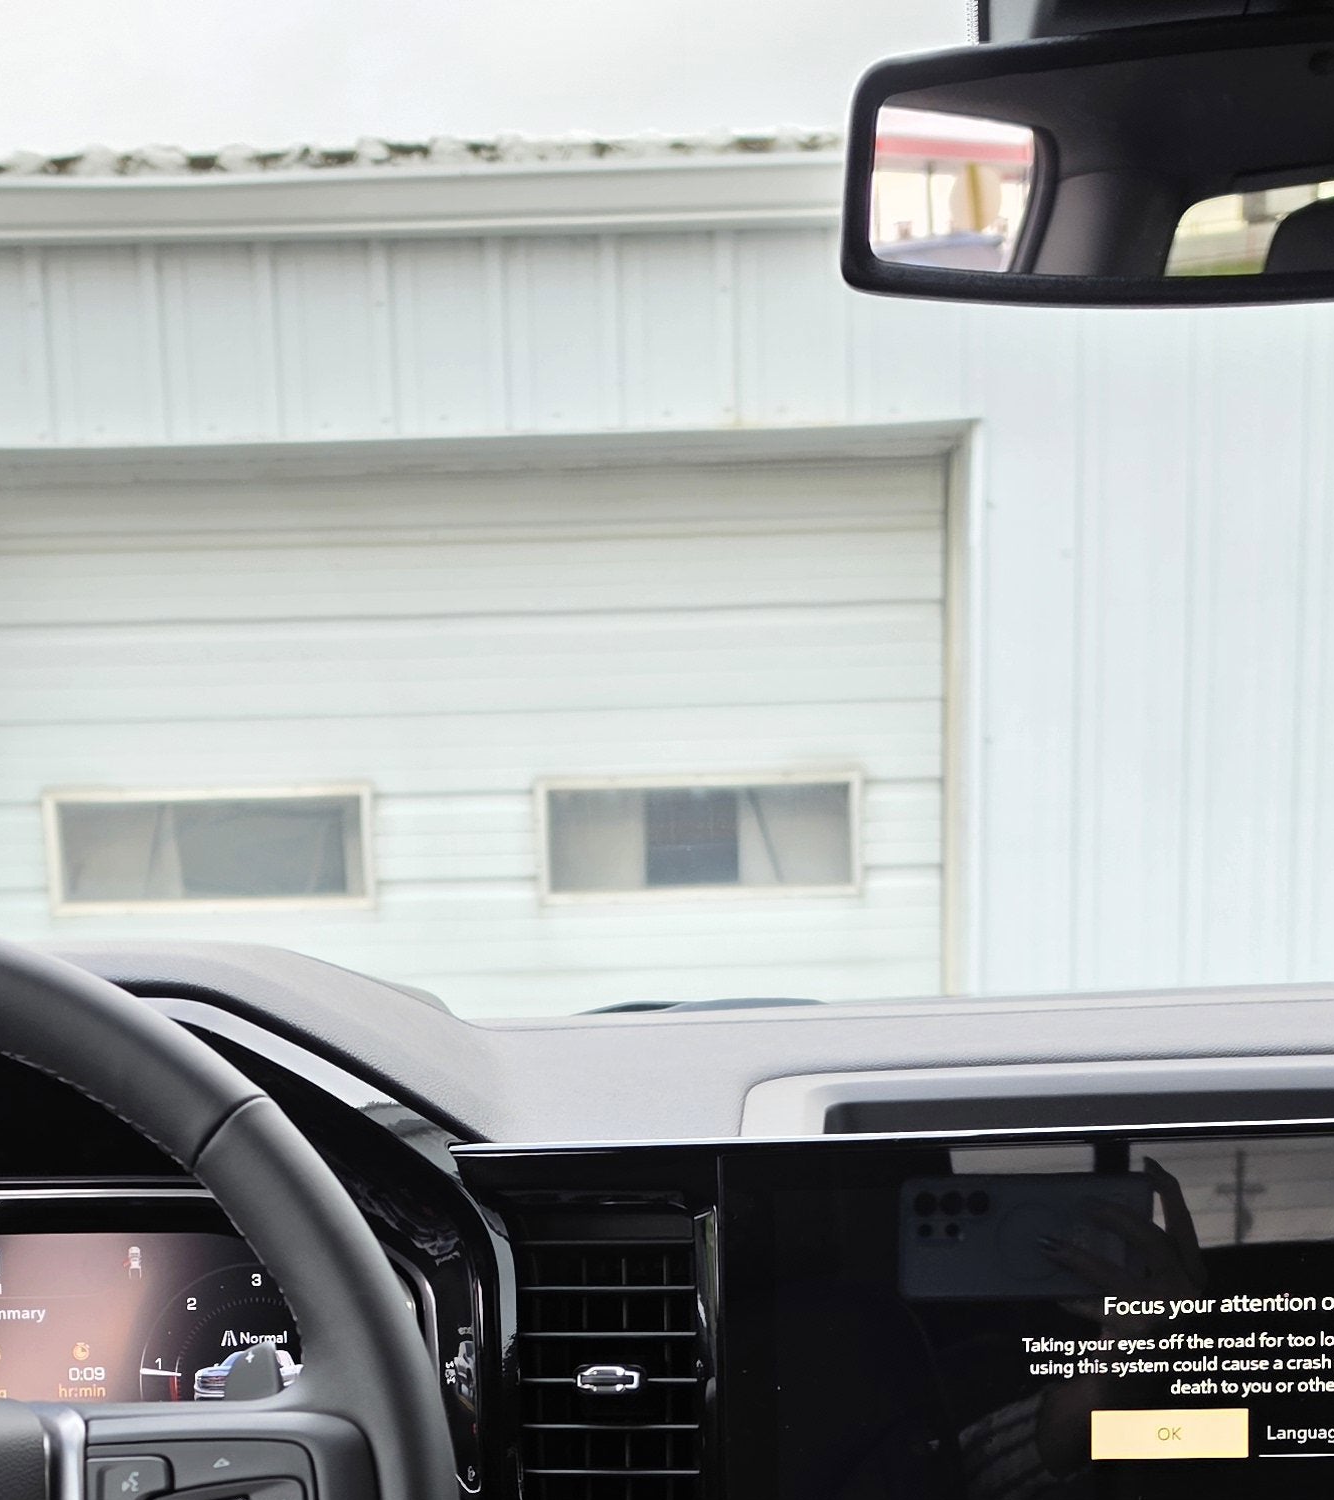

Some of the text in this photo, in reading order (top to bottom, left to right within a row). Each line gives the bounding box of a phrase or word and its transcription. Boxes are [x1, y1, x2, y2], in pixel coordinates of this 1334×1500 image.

[251, 1273, 262, 1287] 3
[186, 1297, 197, 1311] 2
[1104, 1296, 1165, 1316] Focus
[1169, 1298, 1215, 1319] your
[1220, 1292, 1317, 1313] attention
[239, 1330, 288, 1345] Normal
[1022, 1336, 1075, 1356] Taking
[1077, 1340, 1115, 1356] your
[1118, 1340, 1155, 1355] eyes
[1158, 1333, 1184, 1350] off
[1186, 1333, 1214, 1349] the
[1218, 1332, 1255, 1348] road
[1259, 1332, 1284, 1348] for
[1287, 1333, 1316, 1347] too
[155, 1357, 163, 1370] 1
[1030, 1360, 1074, 1378] using
[1077, 1358, 1108, 1374] this
[1111, 1359, 1169, 1377] system
[1173, 1356, 1218, 1372] could
[1221, 1359, 1270, 1371] cause
[1273, 1359, 1283, 1370] a
[1287, 1354, 1331, 1370] crash
[68, 1366, 106, 1381] 0:09
[58, 1384, 106, 1398] hr:min
[1171, 1378, 1218, 1394] death
[1221, 1379, 1238, 1394] to
[1242, 1381, 1271, 1397] you
[1276, 1381, 1294, 1392] or
[1158, 1427, 1182, 1441] OK
